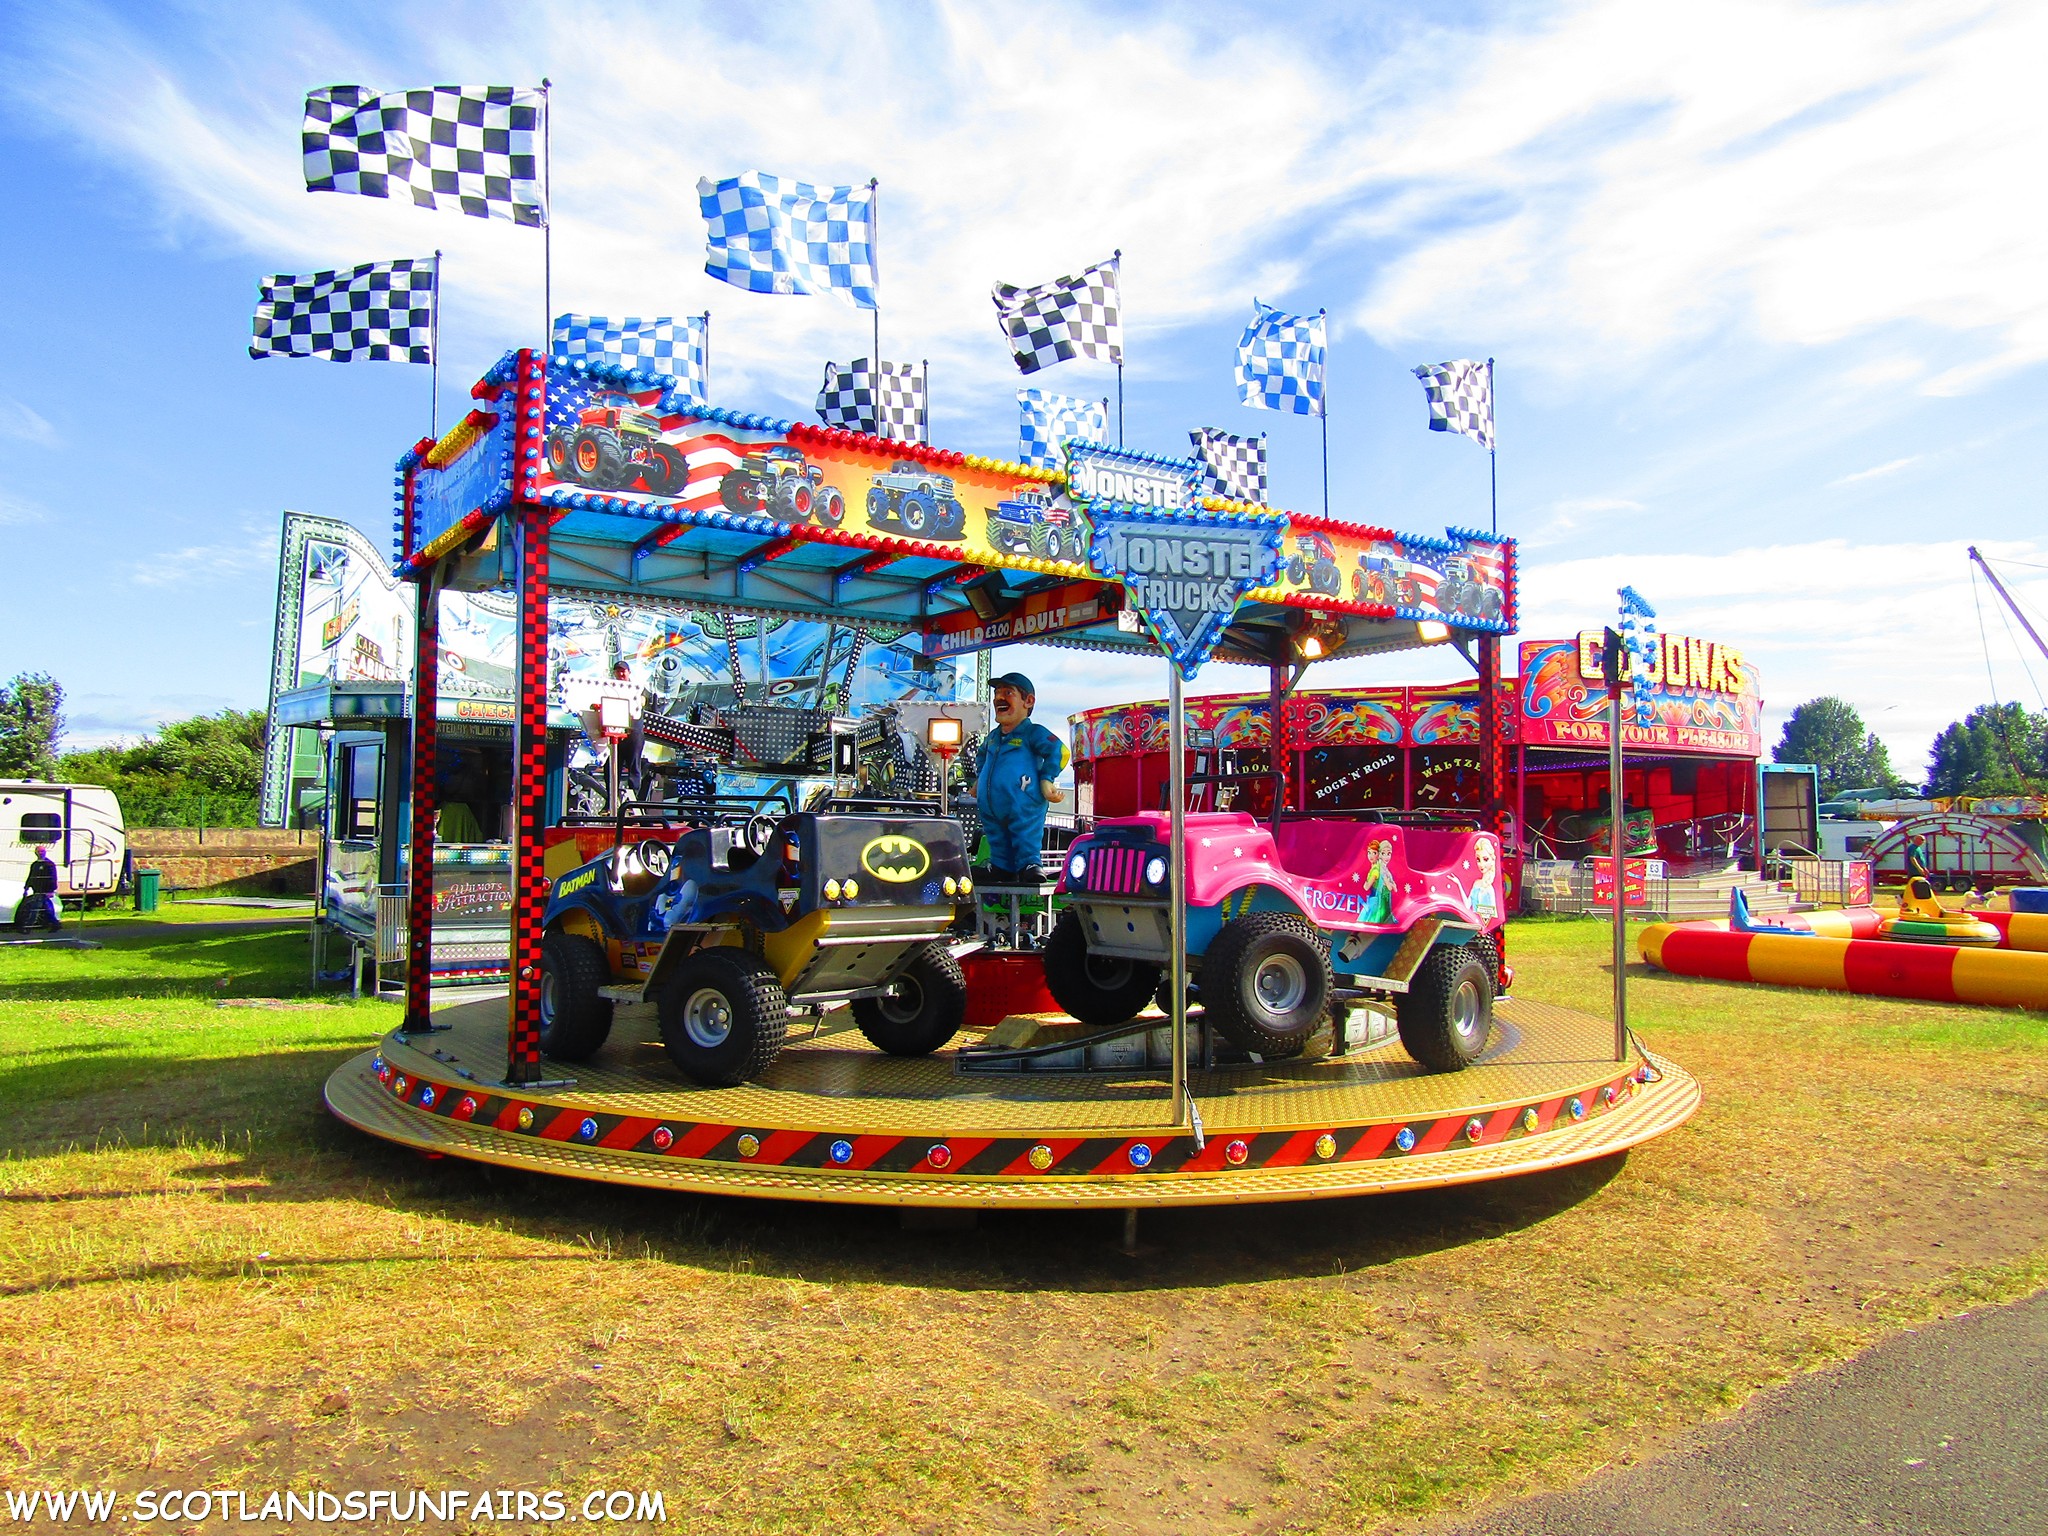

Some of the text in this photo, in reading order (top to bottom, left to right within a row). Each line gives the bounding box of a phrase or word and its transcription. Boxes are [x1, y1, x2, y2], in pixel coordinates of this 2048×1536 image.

[1093, 531, 1277, 580] MONSTER
[1136, 577, 1236, 613] TRUCKS
[941, 626, 984, 651] CHILD
[1013, 607, 1066, 636] ADULT
[357, 635, 379, 659] CAFE
[1553, 720, 1750, 750] FOR YOUR PLEASURE
[1315, 776, 1349, 799] ROCK
[1363, 753, 1396, 775] ROLL
[558, 868, 596, 899] BATMAN
[1650, 864, 1660, 873] £3
[437, 891, 512, 913] ATTRACTION
[1303, 886, 1370, 913] FROZEN
